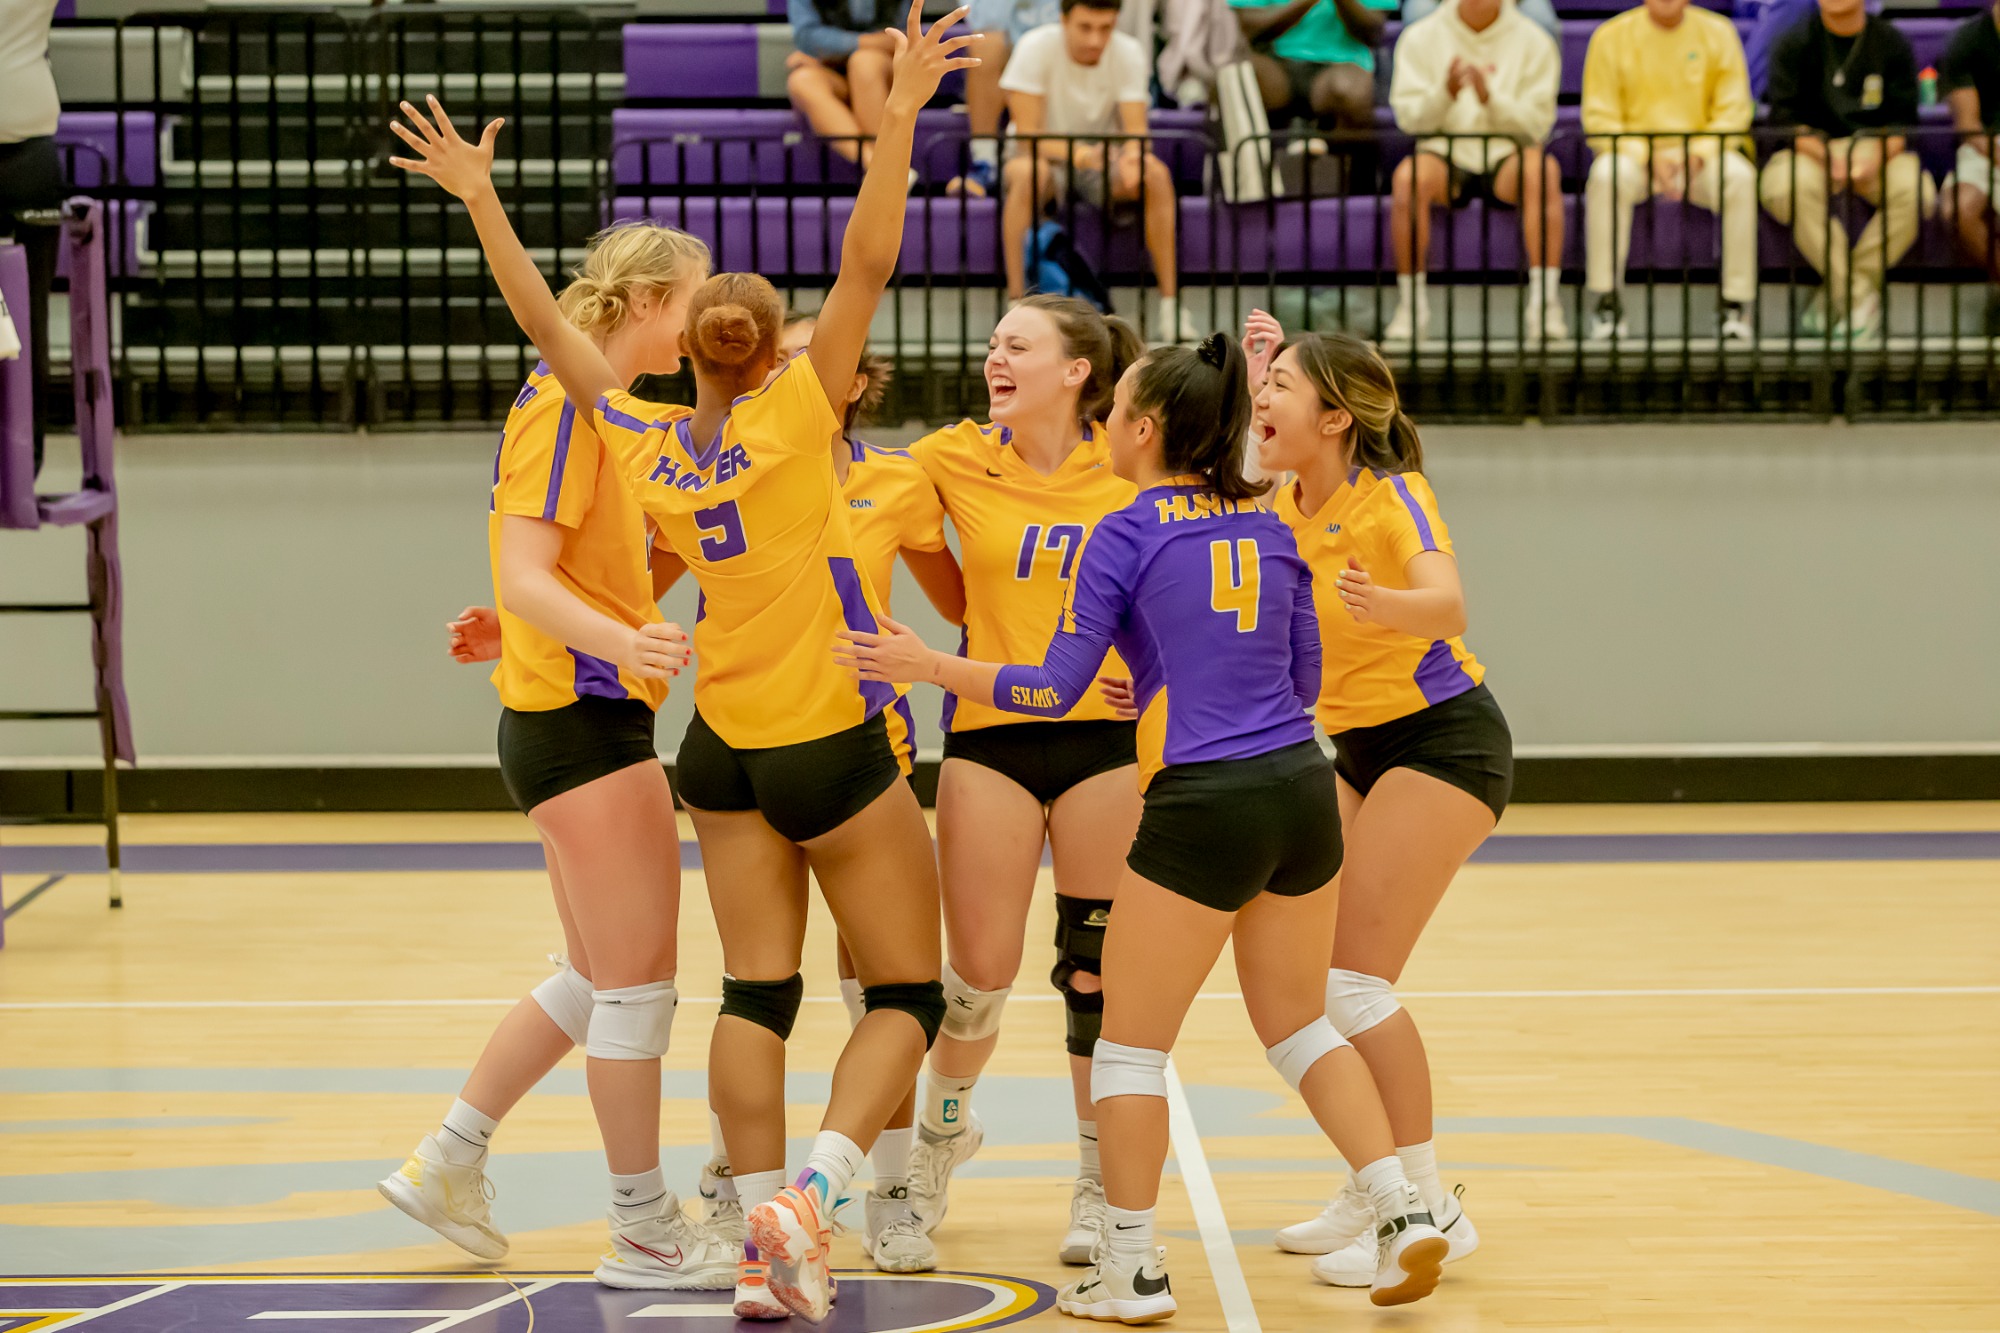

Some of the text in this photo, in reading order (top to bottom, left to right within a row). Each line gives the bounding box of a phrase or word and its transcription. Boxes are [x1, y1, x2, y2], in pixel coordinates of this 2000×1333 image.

[648, 442, 752, 492] HUNER
[1015, 523, 1086, 581] 17
[1210, 538, 1261, 633] 4
